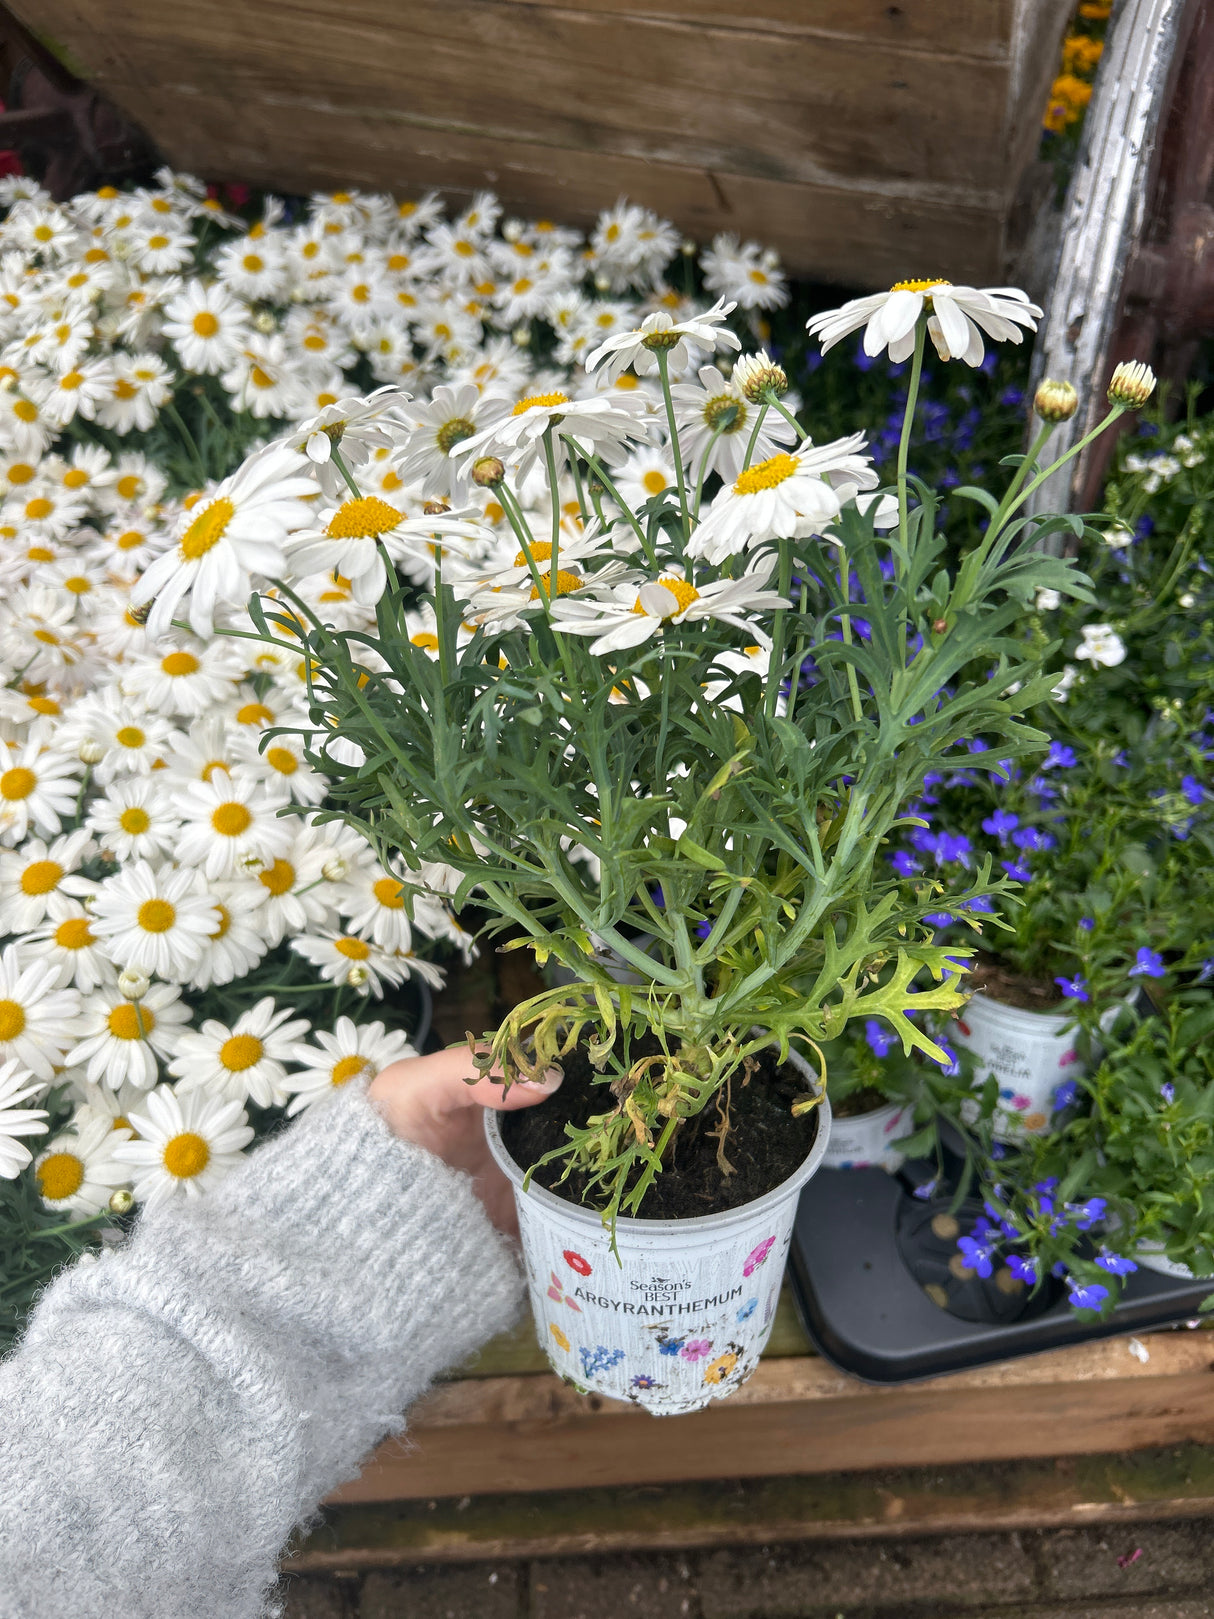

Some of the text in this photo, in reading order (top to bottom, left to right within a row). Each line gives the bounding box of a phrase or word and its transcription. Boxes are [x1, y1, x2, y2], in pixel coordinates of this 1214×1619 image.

[630, 1280, 692, 1291] Season's
[574, 1285, 743, 1316] ARGYRANTHEMUM
[645, 1291, 680, 1302] BEST
